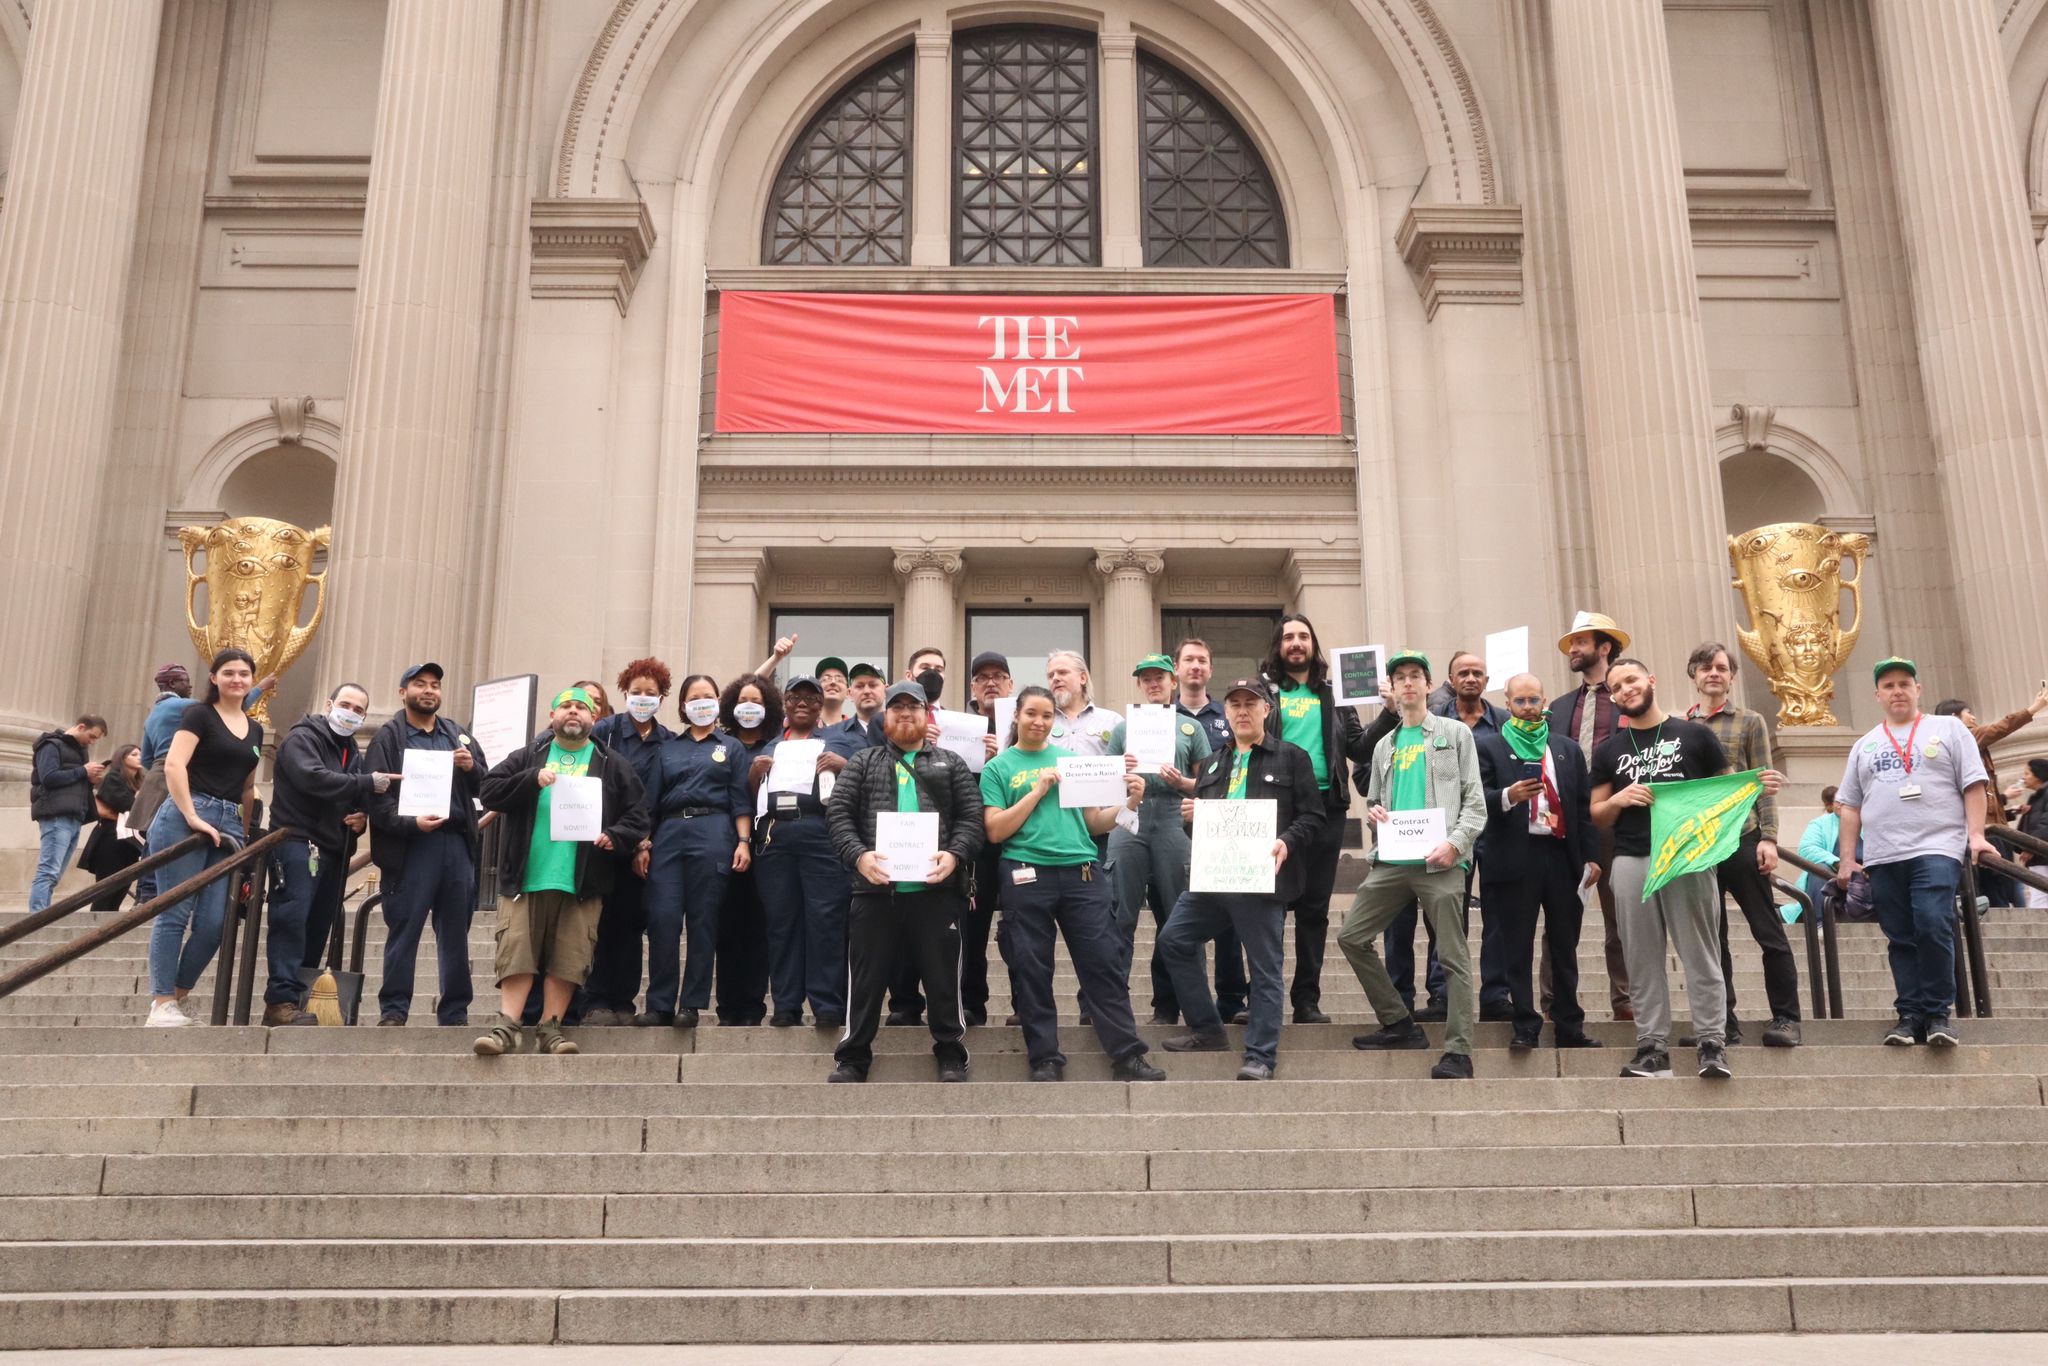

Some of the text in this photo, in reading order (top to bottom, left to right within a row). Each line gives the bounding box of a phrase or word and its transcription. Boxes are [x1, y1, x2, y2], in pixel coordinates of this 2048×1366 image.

[977, 315, 1081, 360] THE
[976, 366, 1084, 413] MET
[1344, 670, 1374, 679] CONTRACT
[1616, 753, 1643, 774] Do
[1625, 752, 1683, 785] You Love
[1217, 804, 1247, 823] WE
[1392, 818, 1430, 826] Contract
[1206, 821, 1268, 838] DESERVE
[1398, 828, 1425, 836] NOW
[889, 841, 925, 849] CONTRACT
